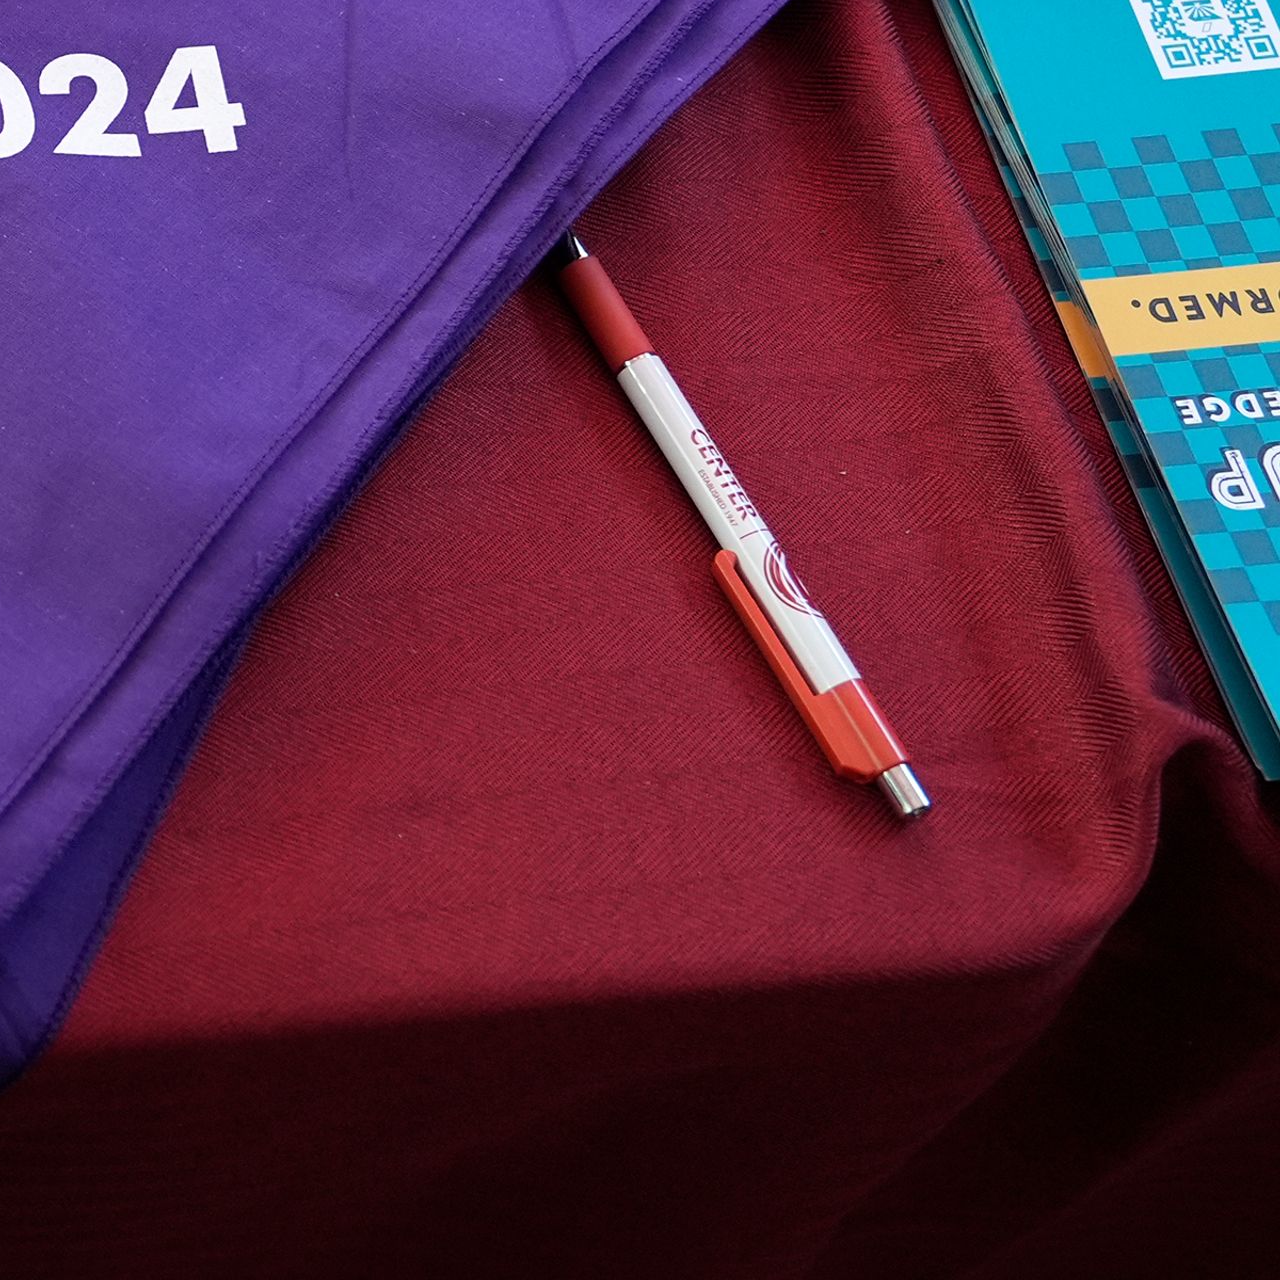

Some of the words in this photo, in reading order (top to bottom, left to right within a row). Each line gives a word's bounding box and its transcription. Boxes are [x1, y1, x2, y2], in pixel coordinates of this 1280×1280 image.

[1130, 287, 1280, 323] RMED.
[690, 428, 757, 521] CENTER
[697, 468, 727, 510] ESTABLISHED
[724, 510, 738, 527] 1947
